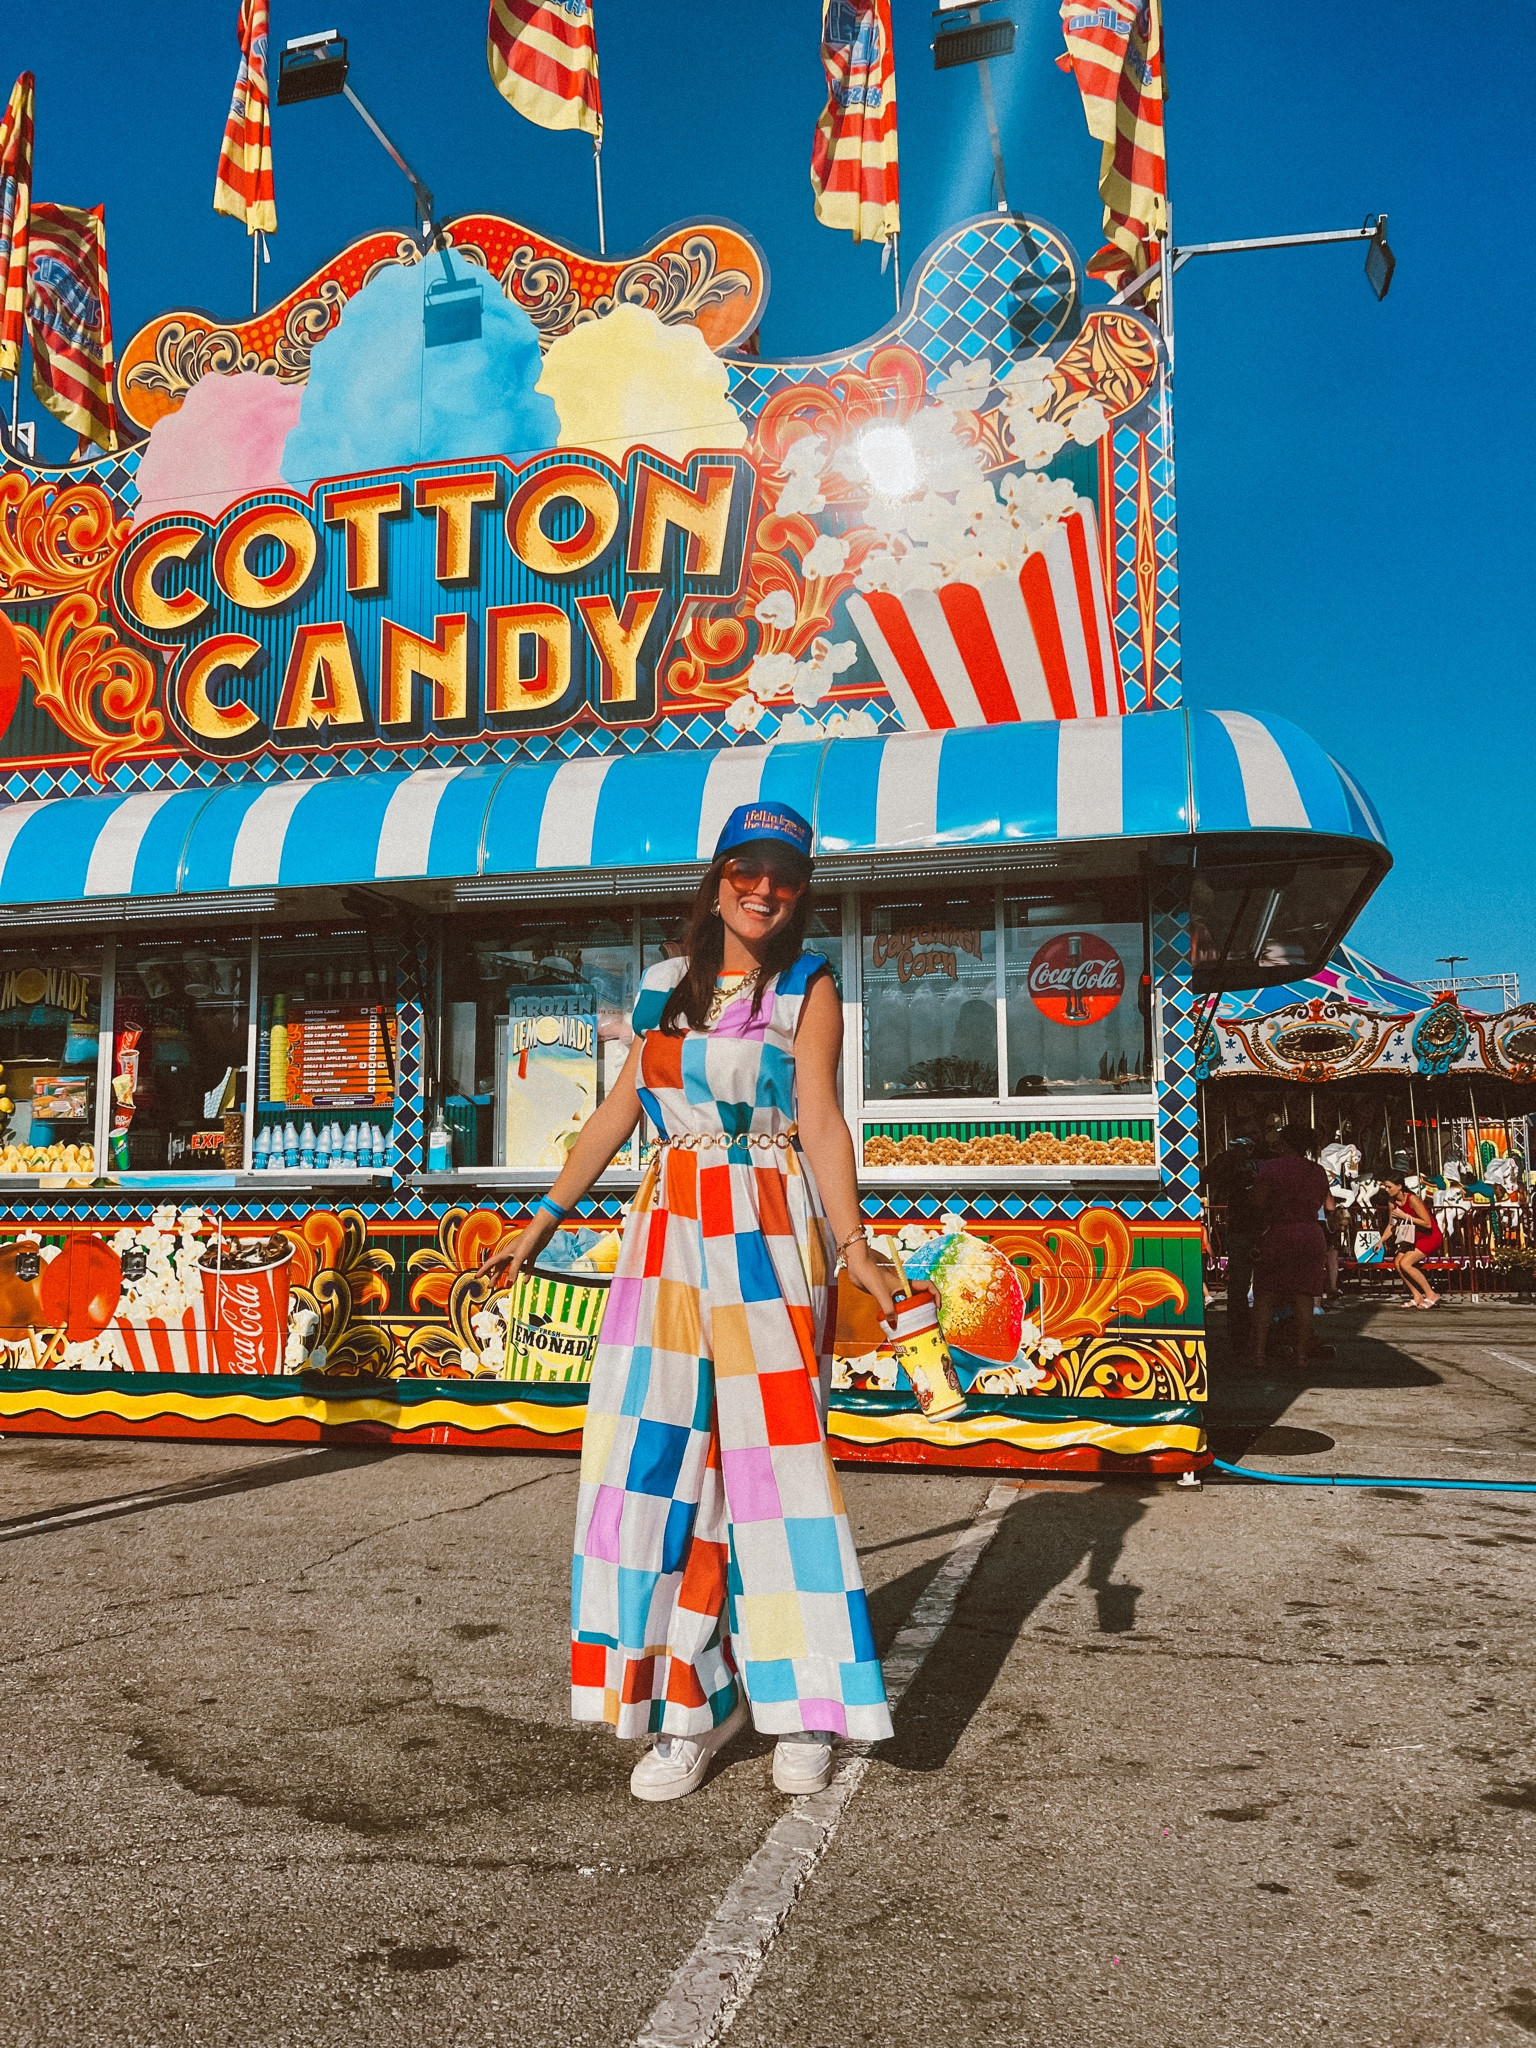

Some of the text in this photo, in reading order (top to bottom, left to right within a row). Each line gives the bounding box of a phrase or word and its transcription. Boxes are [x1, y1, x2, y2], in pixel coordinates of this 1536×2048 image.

[121, 463, 737, 630] COTTON
[176, 588, 663, 741] CANDY
[872, 921, 983, 969] Caramel
[897, 949, 959, 984] Corn
[1030, 959, 1120, 992] Coca-Cola
[514, 995, 592, 1017] FROZEN
[513, 1016, 593, 1058] LEMONADE
[511, 1317, 598, 1362] LEMONADE
[539, 1327, 561, 1337] FRESH
